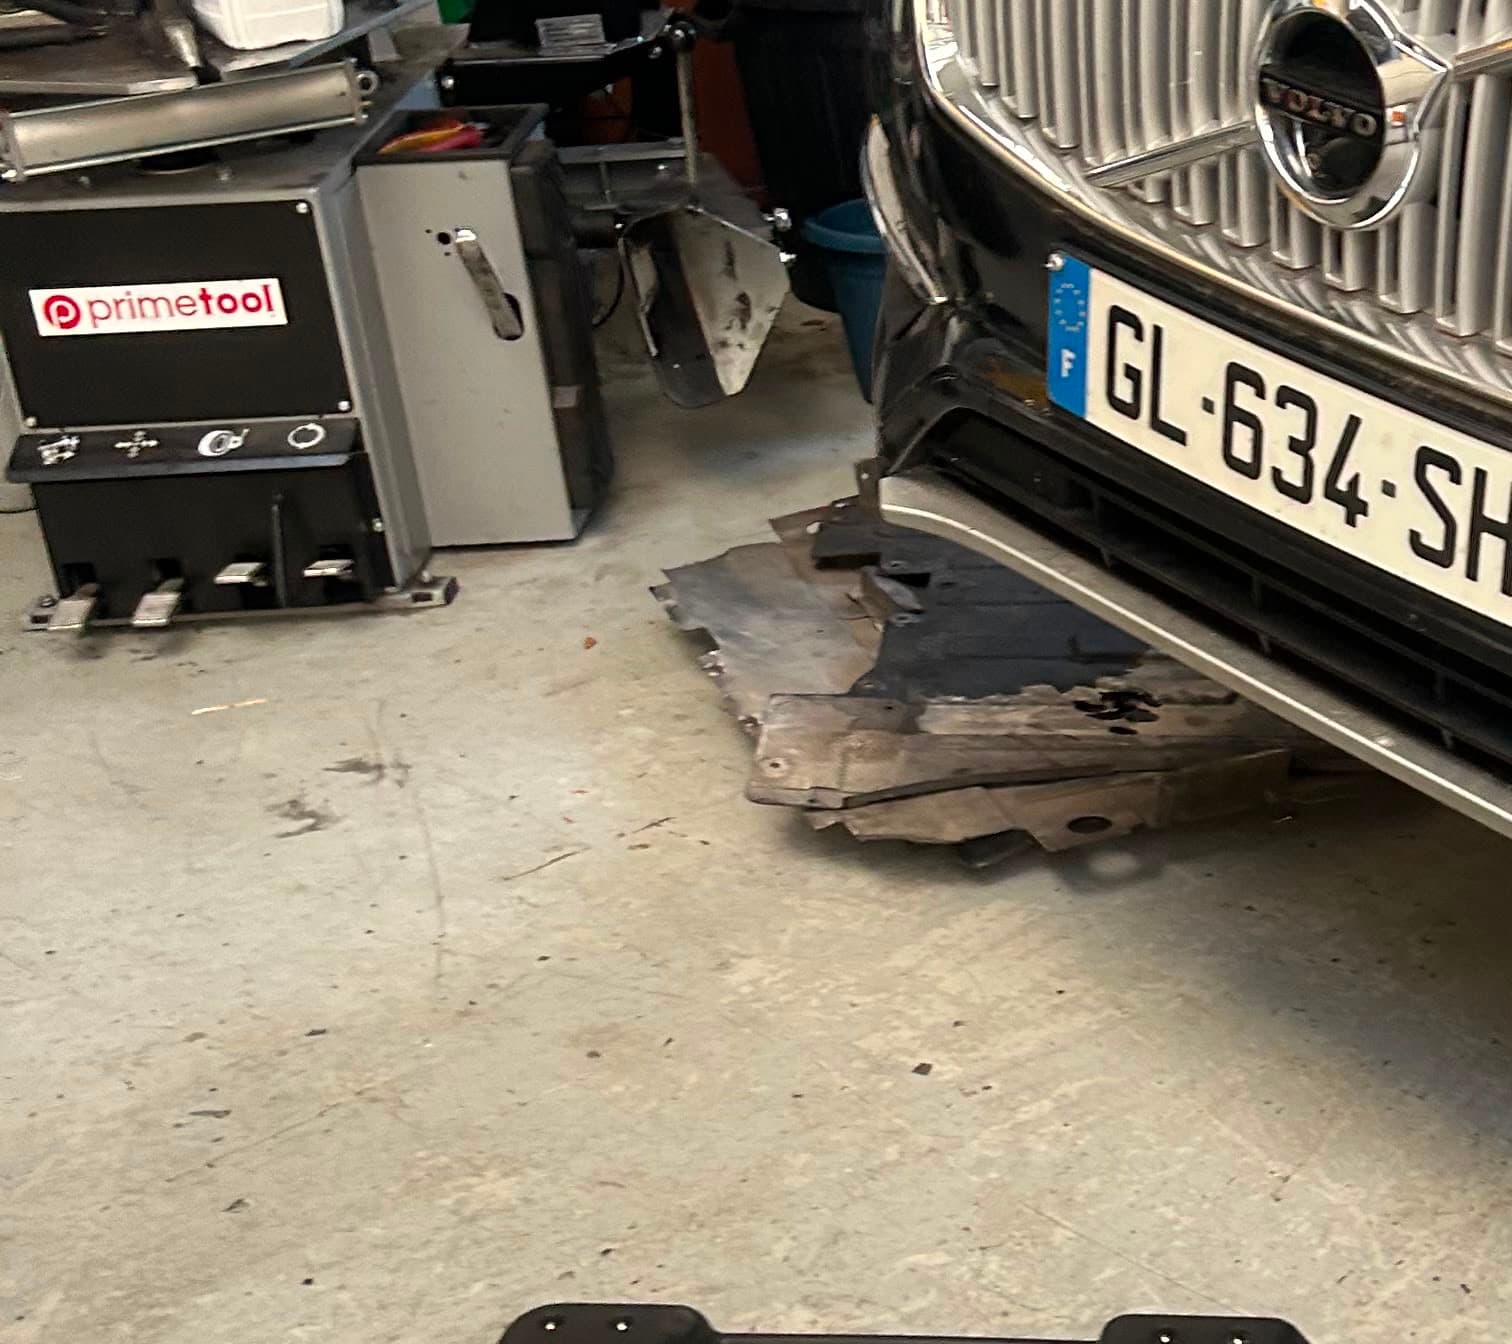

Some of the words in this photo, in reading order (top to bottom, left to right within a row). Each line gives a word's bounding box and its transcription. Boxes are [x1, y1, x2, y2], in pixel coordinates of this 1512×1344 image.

[1261, 77, 1377, 137] VOLVO
[86, 284, 275, 328] primetool
[1060, 349, 1076, 377] F
